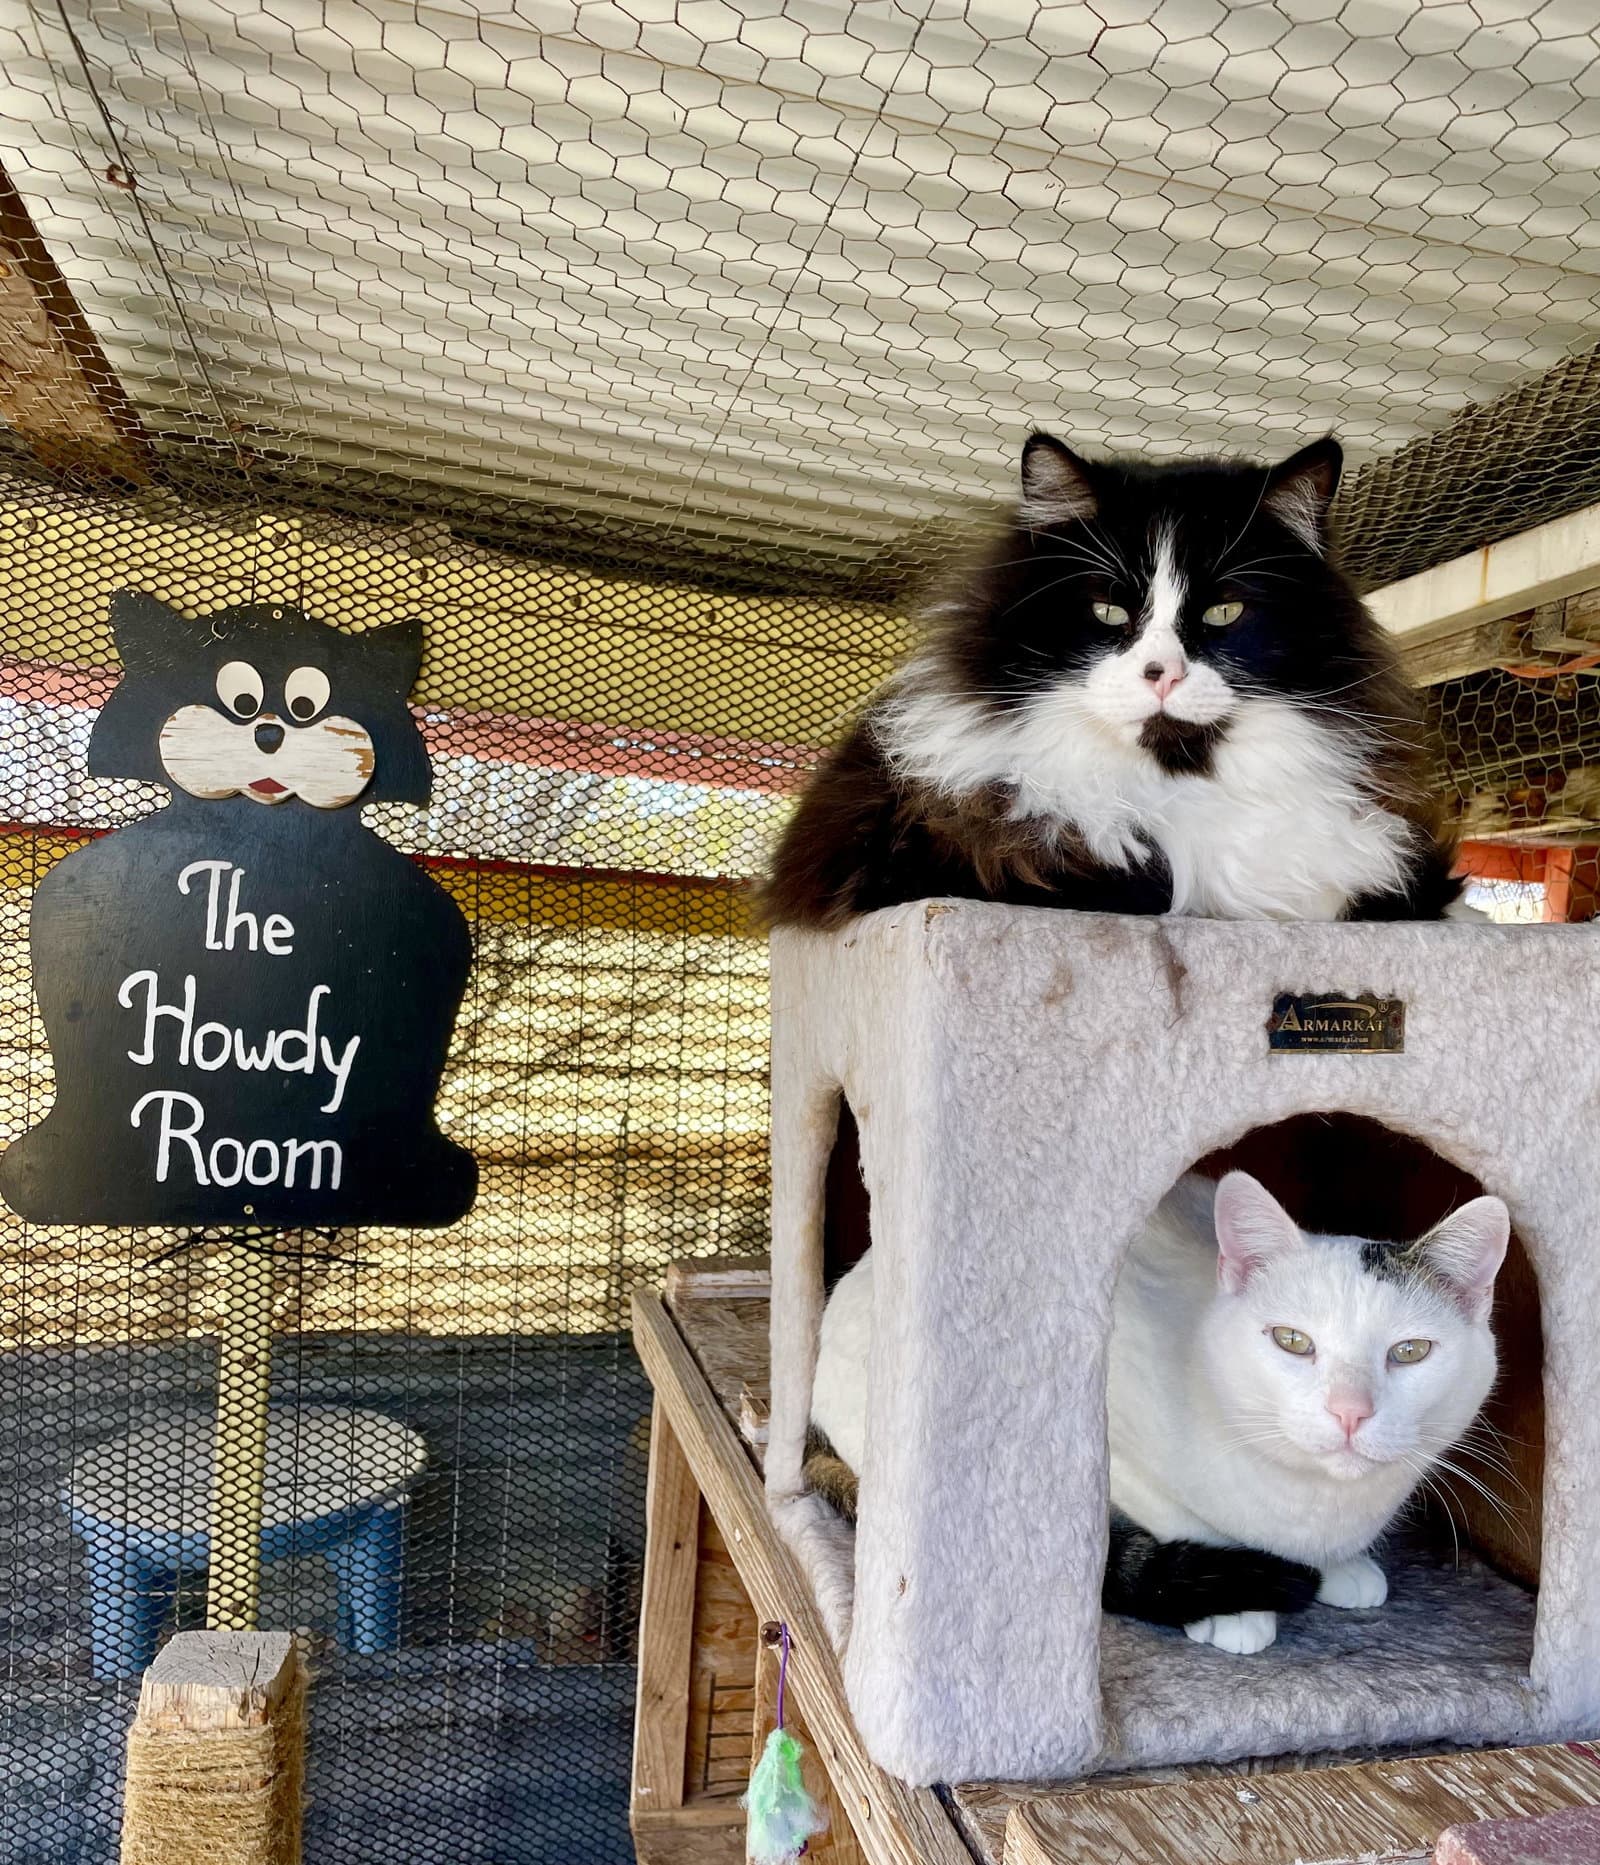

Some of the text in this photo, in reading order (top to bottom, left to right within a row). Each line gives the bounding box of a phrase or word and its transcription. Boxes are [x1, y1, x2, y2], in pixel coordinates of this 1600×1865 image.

[178, 859, 295, 955] The
[117, 970, 361, 1114] Howdy
[1279, 1004, 1384, 1032] ARMARKAT
[131, 1090, 342, 1190] Room
